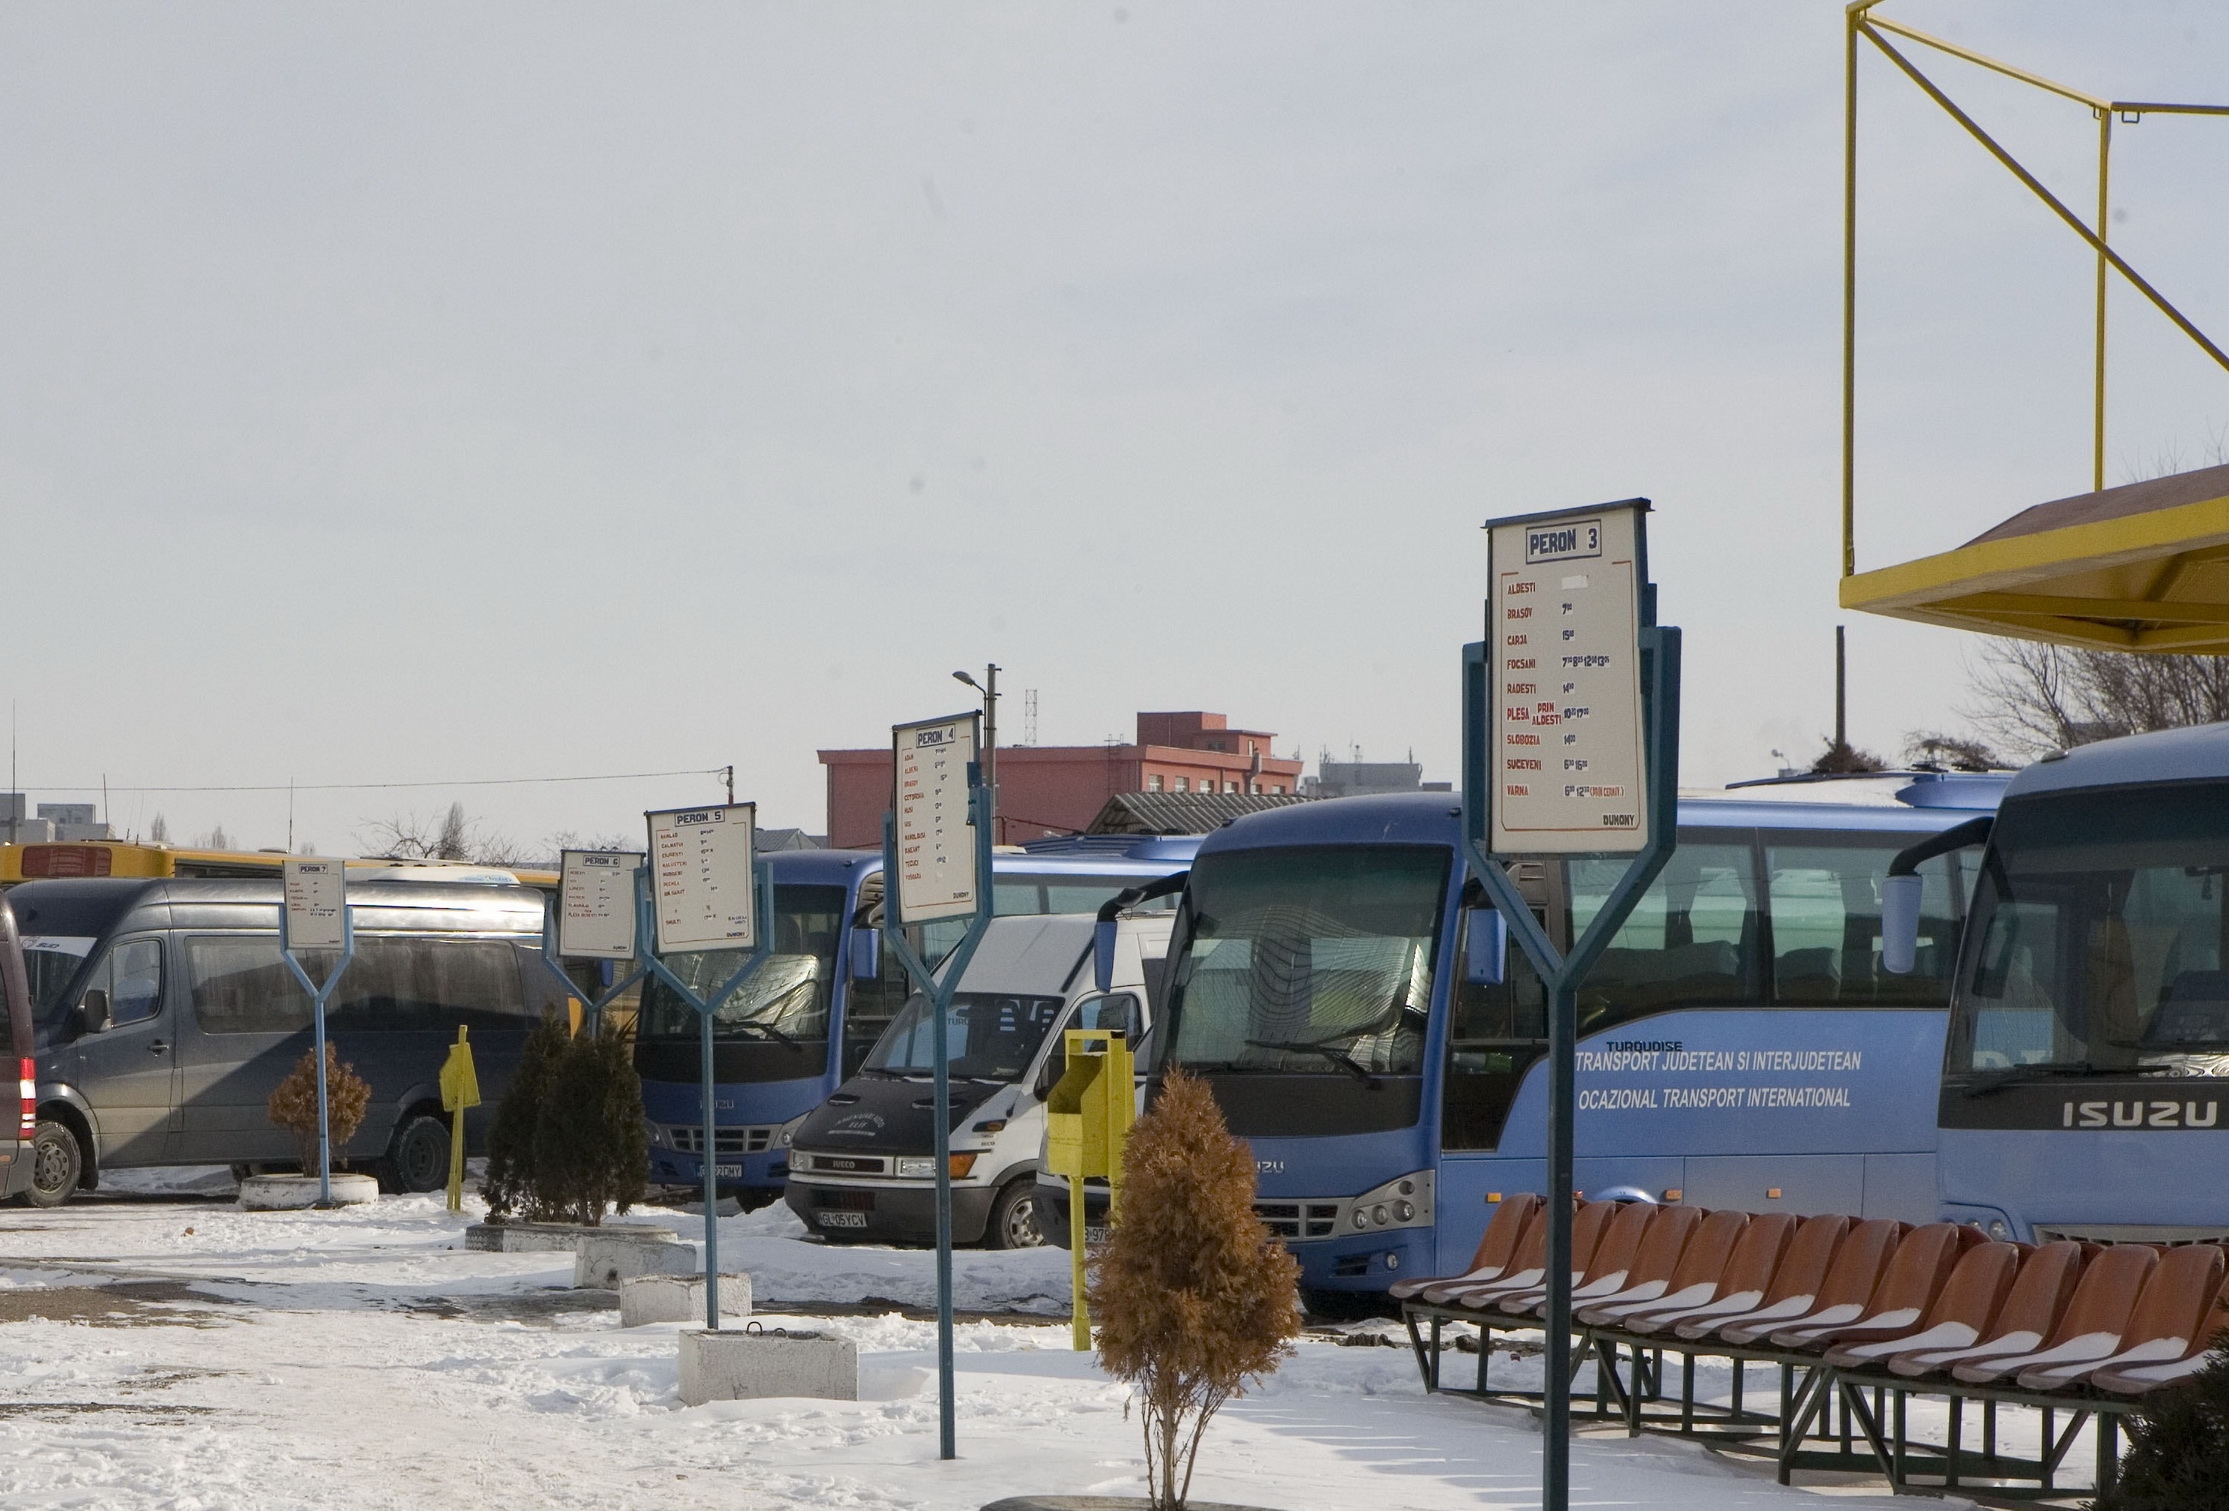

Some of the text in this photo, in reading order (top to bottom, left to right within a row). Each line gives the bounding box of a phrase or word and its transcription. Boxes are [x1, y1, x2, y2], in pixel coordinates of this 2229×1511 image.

[1530, 528, 1598, 555] PERON 3
[1507, 582, 1536, 595] ALDESTI
[1507, 607, 1533, 620] BRASOV
[1507, 634, 1528, 646] CARJA
[1506, 658, 1536, 670] FOCSANI
[1507, 683, 1537, 695] RADESTI
[1537, 702, 1555, 713] PRIN
[1506, 707, 1530, 721] PLESA
[1532, 714, 1562, 725] ALDESTI
[917, 727, 954, 746] PERON 4
[1506, 734, 1541, 746] SLOBOZIA
[1506, 758, 1542, 771] SUCEVENI
[1506, 784, 1529, 796] VARNA
[677, 811, 721, 824] PERON 5
[1603, 814, 1635, 826] DUMONY
[584, 857, 618, 866] PERON 6
[1606, 1041, 1683, 1053] TURQUOISE
[1576, 1051, 1861, 1071] TRANSPORT JUDETEAN SI INTERJUDETEAN
[1578, 1087, 1851, 1110] OCAZIONAL TRANSPORT INTERNATIONAL
[2062, 1101, 2218, 1127] ISUZU
[832, 1160, 856, 1170] IVECO
